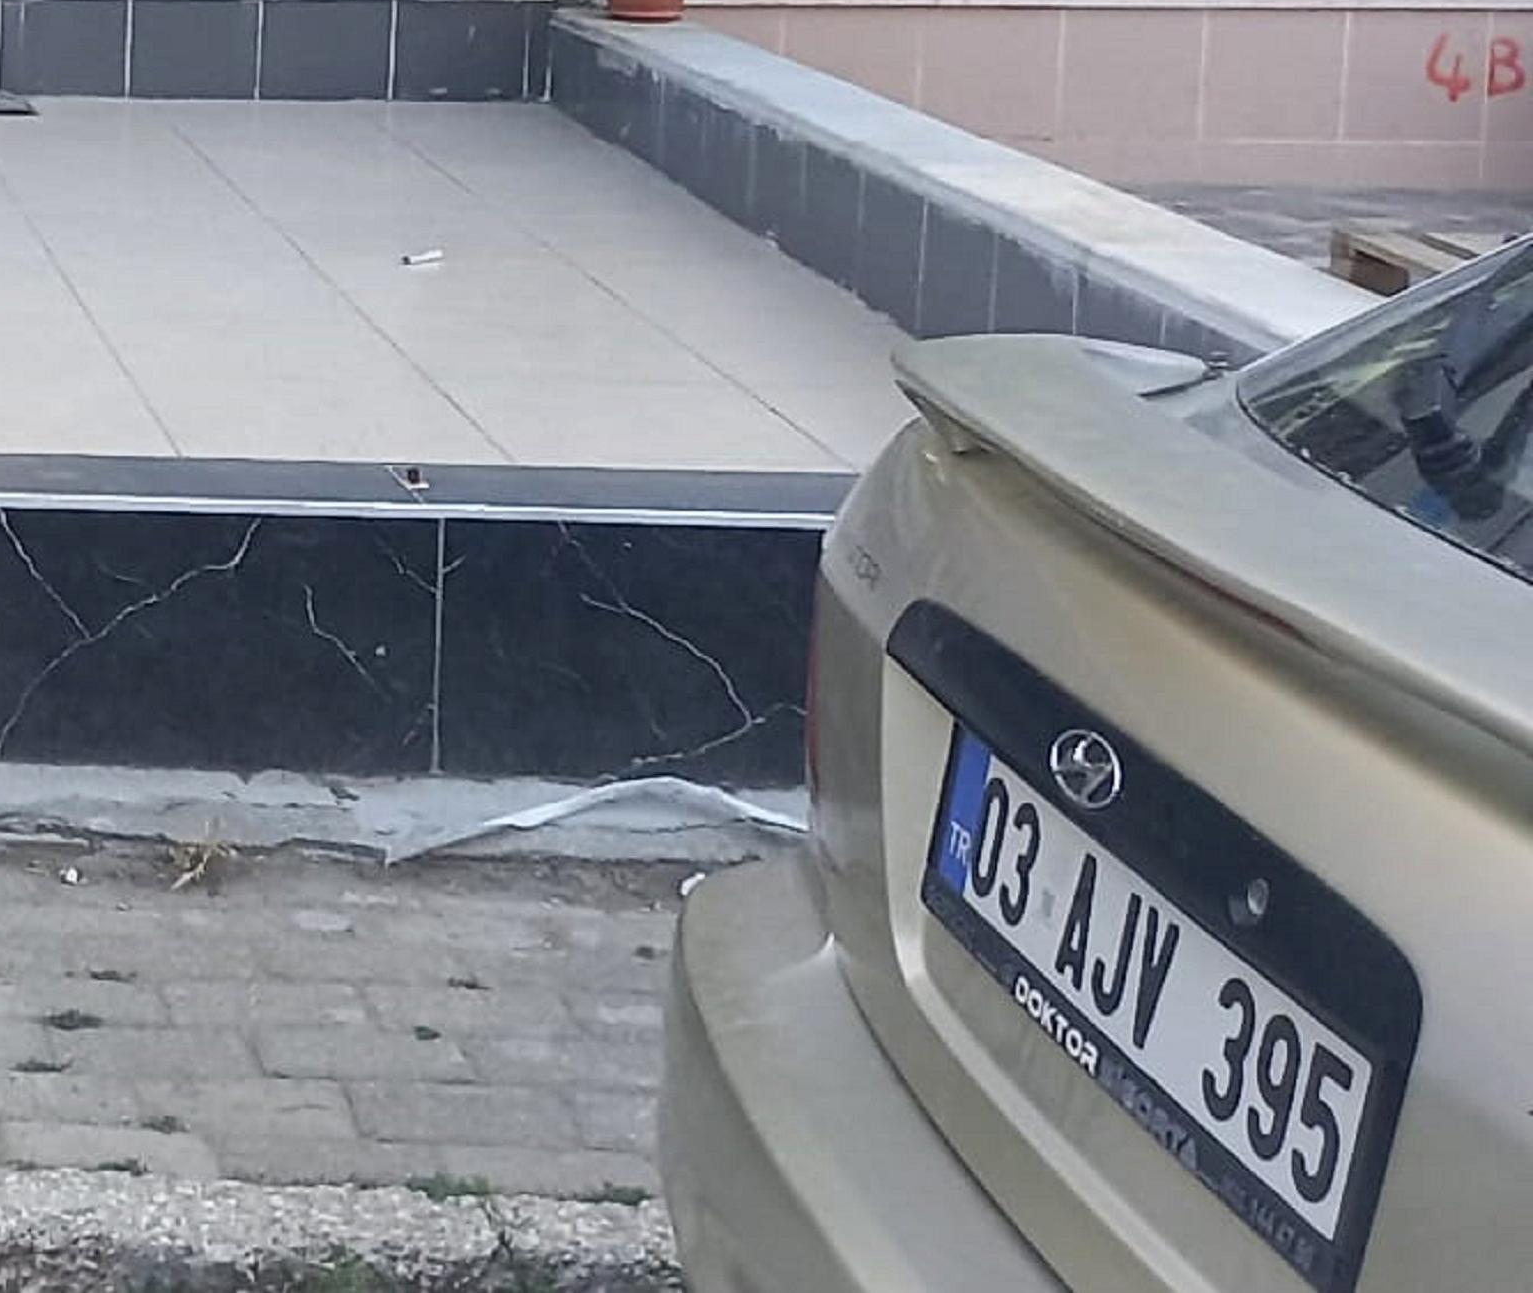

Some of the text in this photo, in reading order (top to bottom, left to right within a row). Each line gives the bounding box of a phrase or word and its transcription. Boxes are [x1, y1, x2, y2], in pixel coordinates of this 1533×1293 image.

[946, 821, 972, 866] TR
[970, 776, 1042, 927] 03
[1055, 853, 1181, 1050] AJV
[1200, 976, 1356, 1205] 395
[1014, 974, 1100, 1078] DOKTOR
